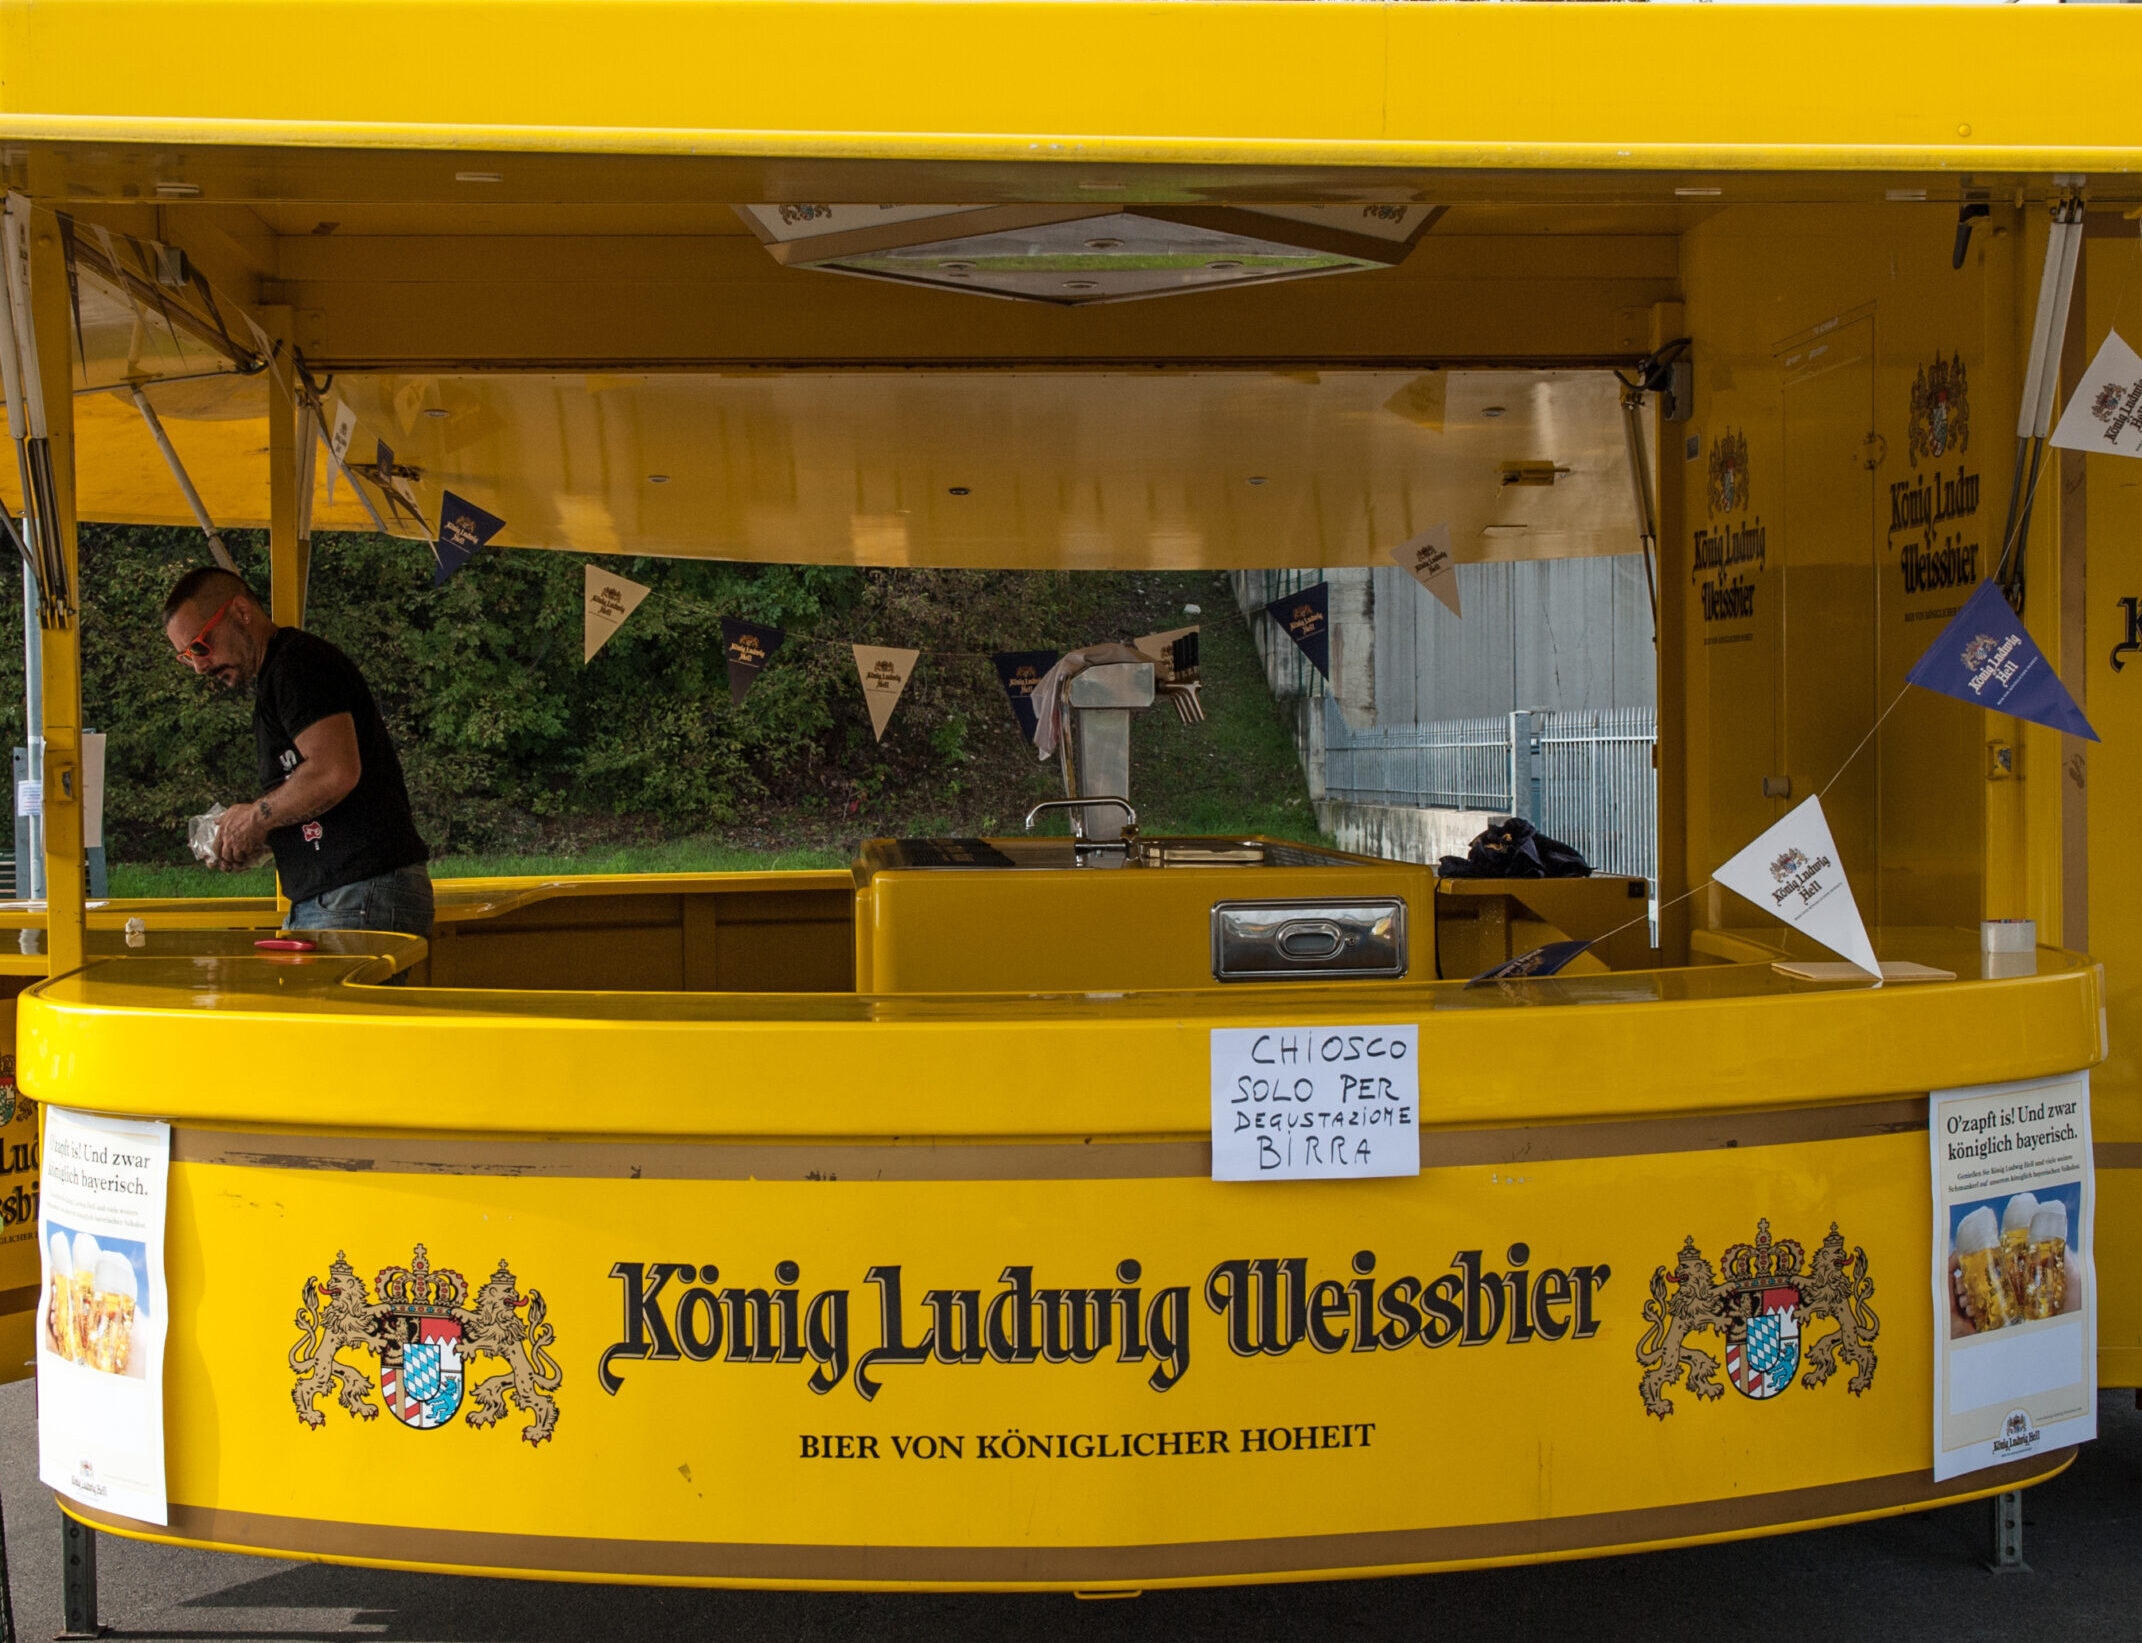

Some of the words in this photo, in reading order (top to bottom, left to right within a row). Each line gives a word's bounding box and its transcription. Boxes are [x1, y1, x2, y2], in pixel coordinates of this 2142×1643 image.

[1888, 472, 1931, 551] König
[1901, 531, 1979, 594] Weissbier
[1702, 573, 1755, 622] Weissbier
[1968, 665, 1997, 696] König
[1987, 634, 2022, 670] Ludwig
[1995, 660, 2019, 688] Hell
[1772, 880, 1802, 907] König
[1796, 856, 1831, 885] Ludwig
[1798, 880, 1822, 905] Hell
[1251, 1030, 1407, 1064] CHIOSCO
[1231, 1075, 1314, 1104] SOLO
[1340, 1074, 1400, 1103] PER
[2000, 1107, 2016, 1127] is!
[2018, 1102, 2045, 1123] Und
[2048, 1101, 2077, 1118] zwar
[84, 1144, 108, 1165] Und
[112, 1153, 151, 1169] zwar
[1257, 1130, 1371, 1169] BIRRA
[1948, 1134, 2012, 1160] königlich
[2016, 1123, 2078, 1150] bayerisch.
[81, 1169, 149, 1196] bayerisch.
[599, 1261, 849, 1396] König
[854, 1258, 1191, 1402] Ludwig
[1205, 1242, 1611, 1357] Weissbier
[800, 1434, 881, 1458] BIER
[891, 1434, 965, 1458] VON
[976, 1428, 1230, 1458] KÖNIGLICHER
[1240, 1423, 1376, 1453] HOHEIT
